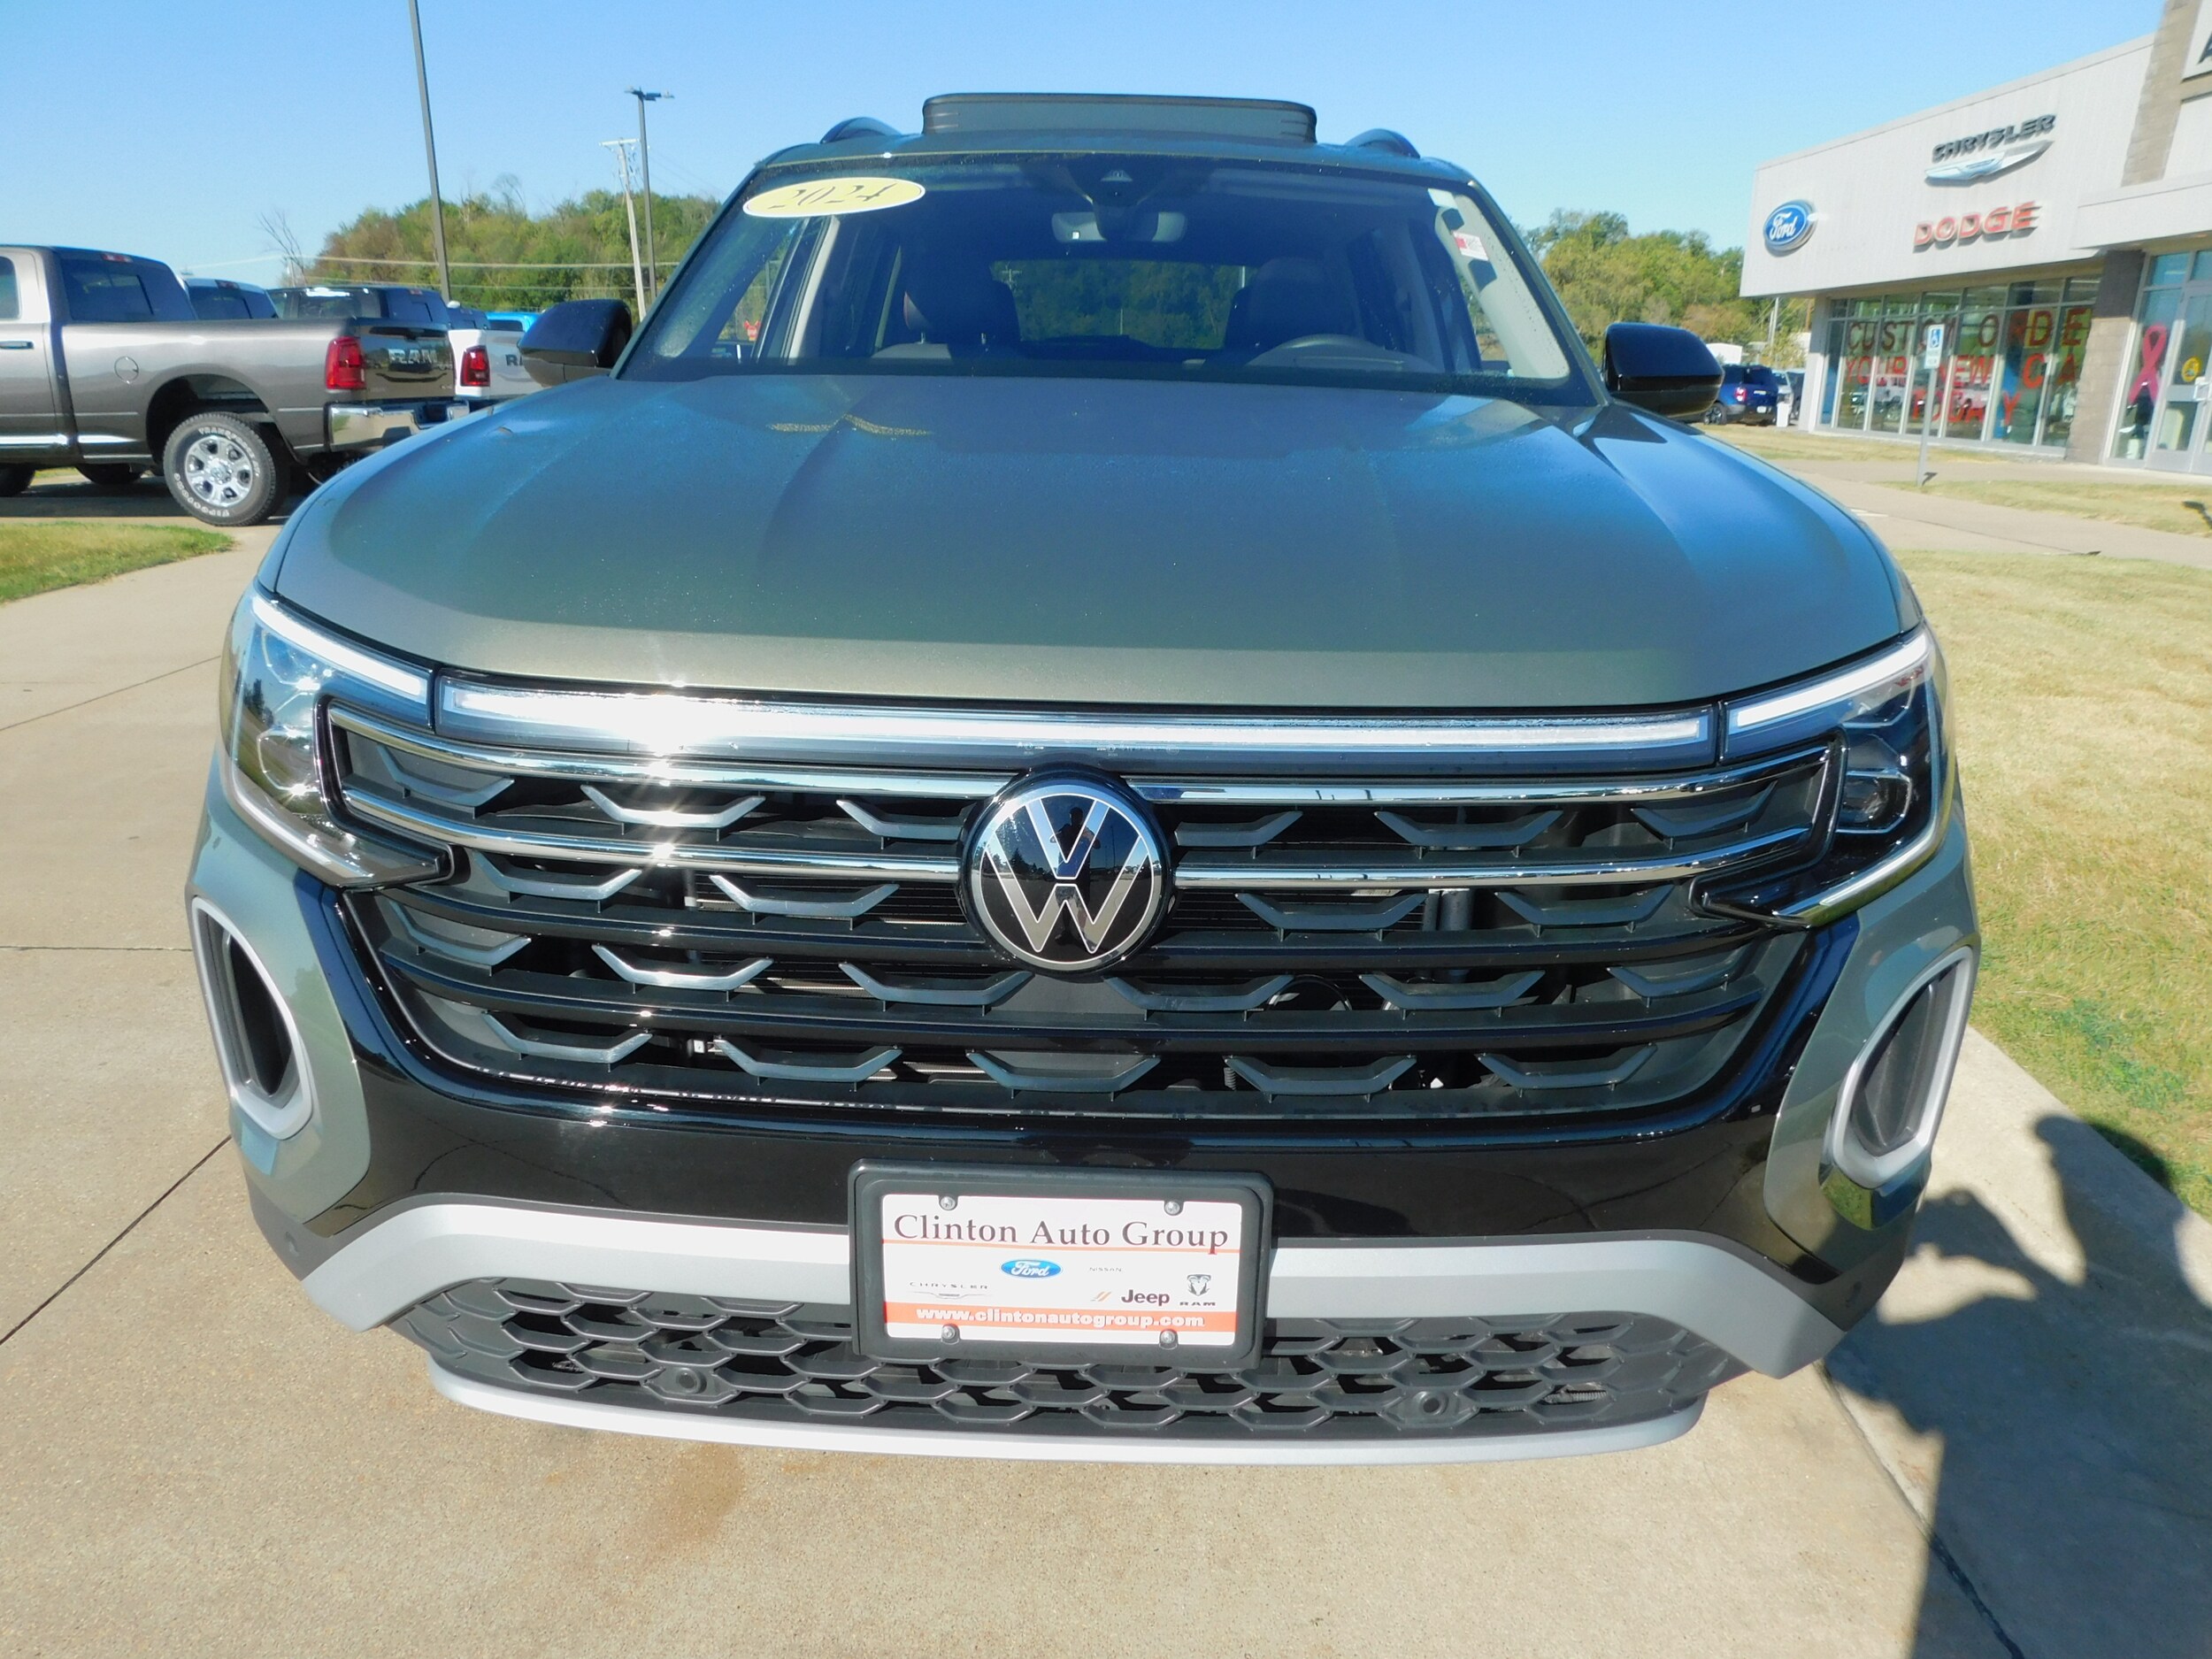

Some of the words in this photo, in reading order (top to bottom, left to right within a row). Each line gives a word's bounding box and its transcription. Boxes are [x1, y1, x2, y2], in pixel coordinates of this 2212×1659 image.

[1932, 114, 2056, 162] CHRYSLER
[767, 182, 898, 211] 2024
[1769, 211, 1800, 242] Ford
[1913, 201, 2038, 248] DODGE
[1978, 307, 2088, 349] ORDE
[388, 348, 439, 365] RAM
[2022, 352, 2078, 388] CA
[983, 796, 1150, 955] VW
[894, 1214, 1018, 1243] Clinton
[1029, 1220, 1110, 1246] Auto
[1121, 1221, 1229, 1255] Group
[1010, 1260, 1051, 1278] Ford
[1121, 1289, 1171, 1306] Jeep
[916, 1308, 1205, 1328] www.clintonautogroup.com
